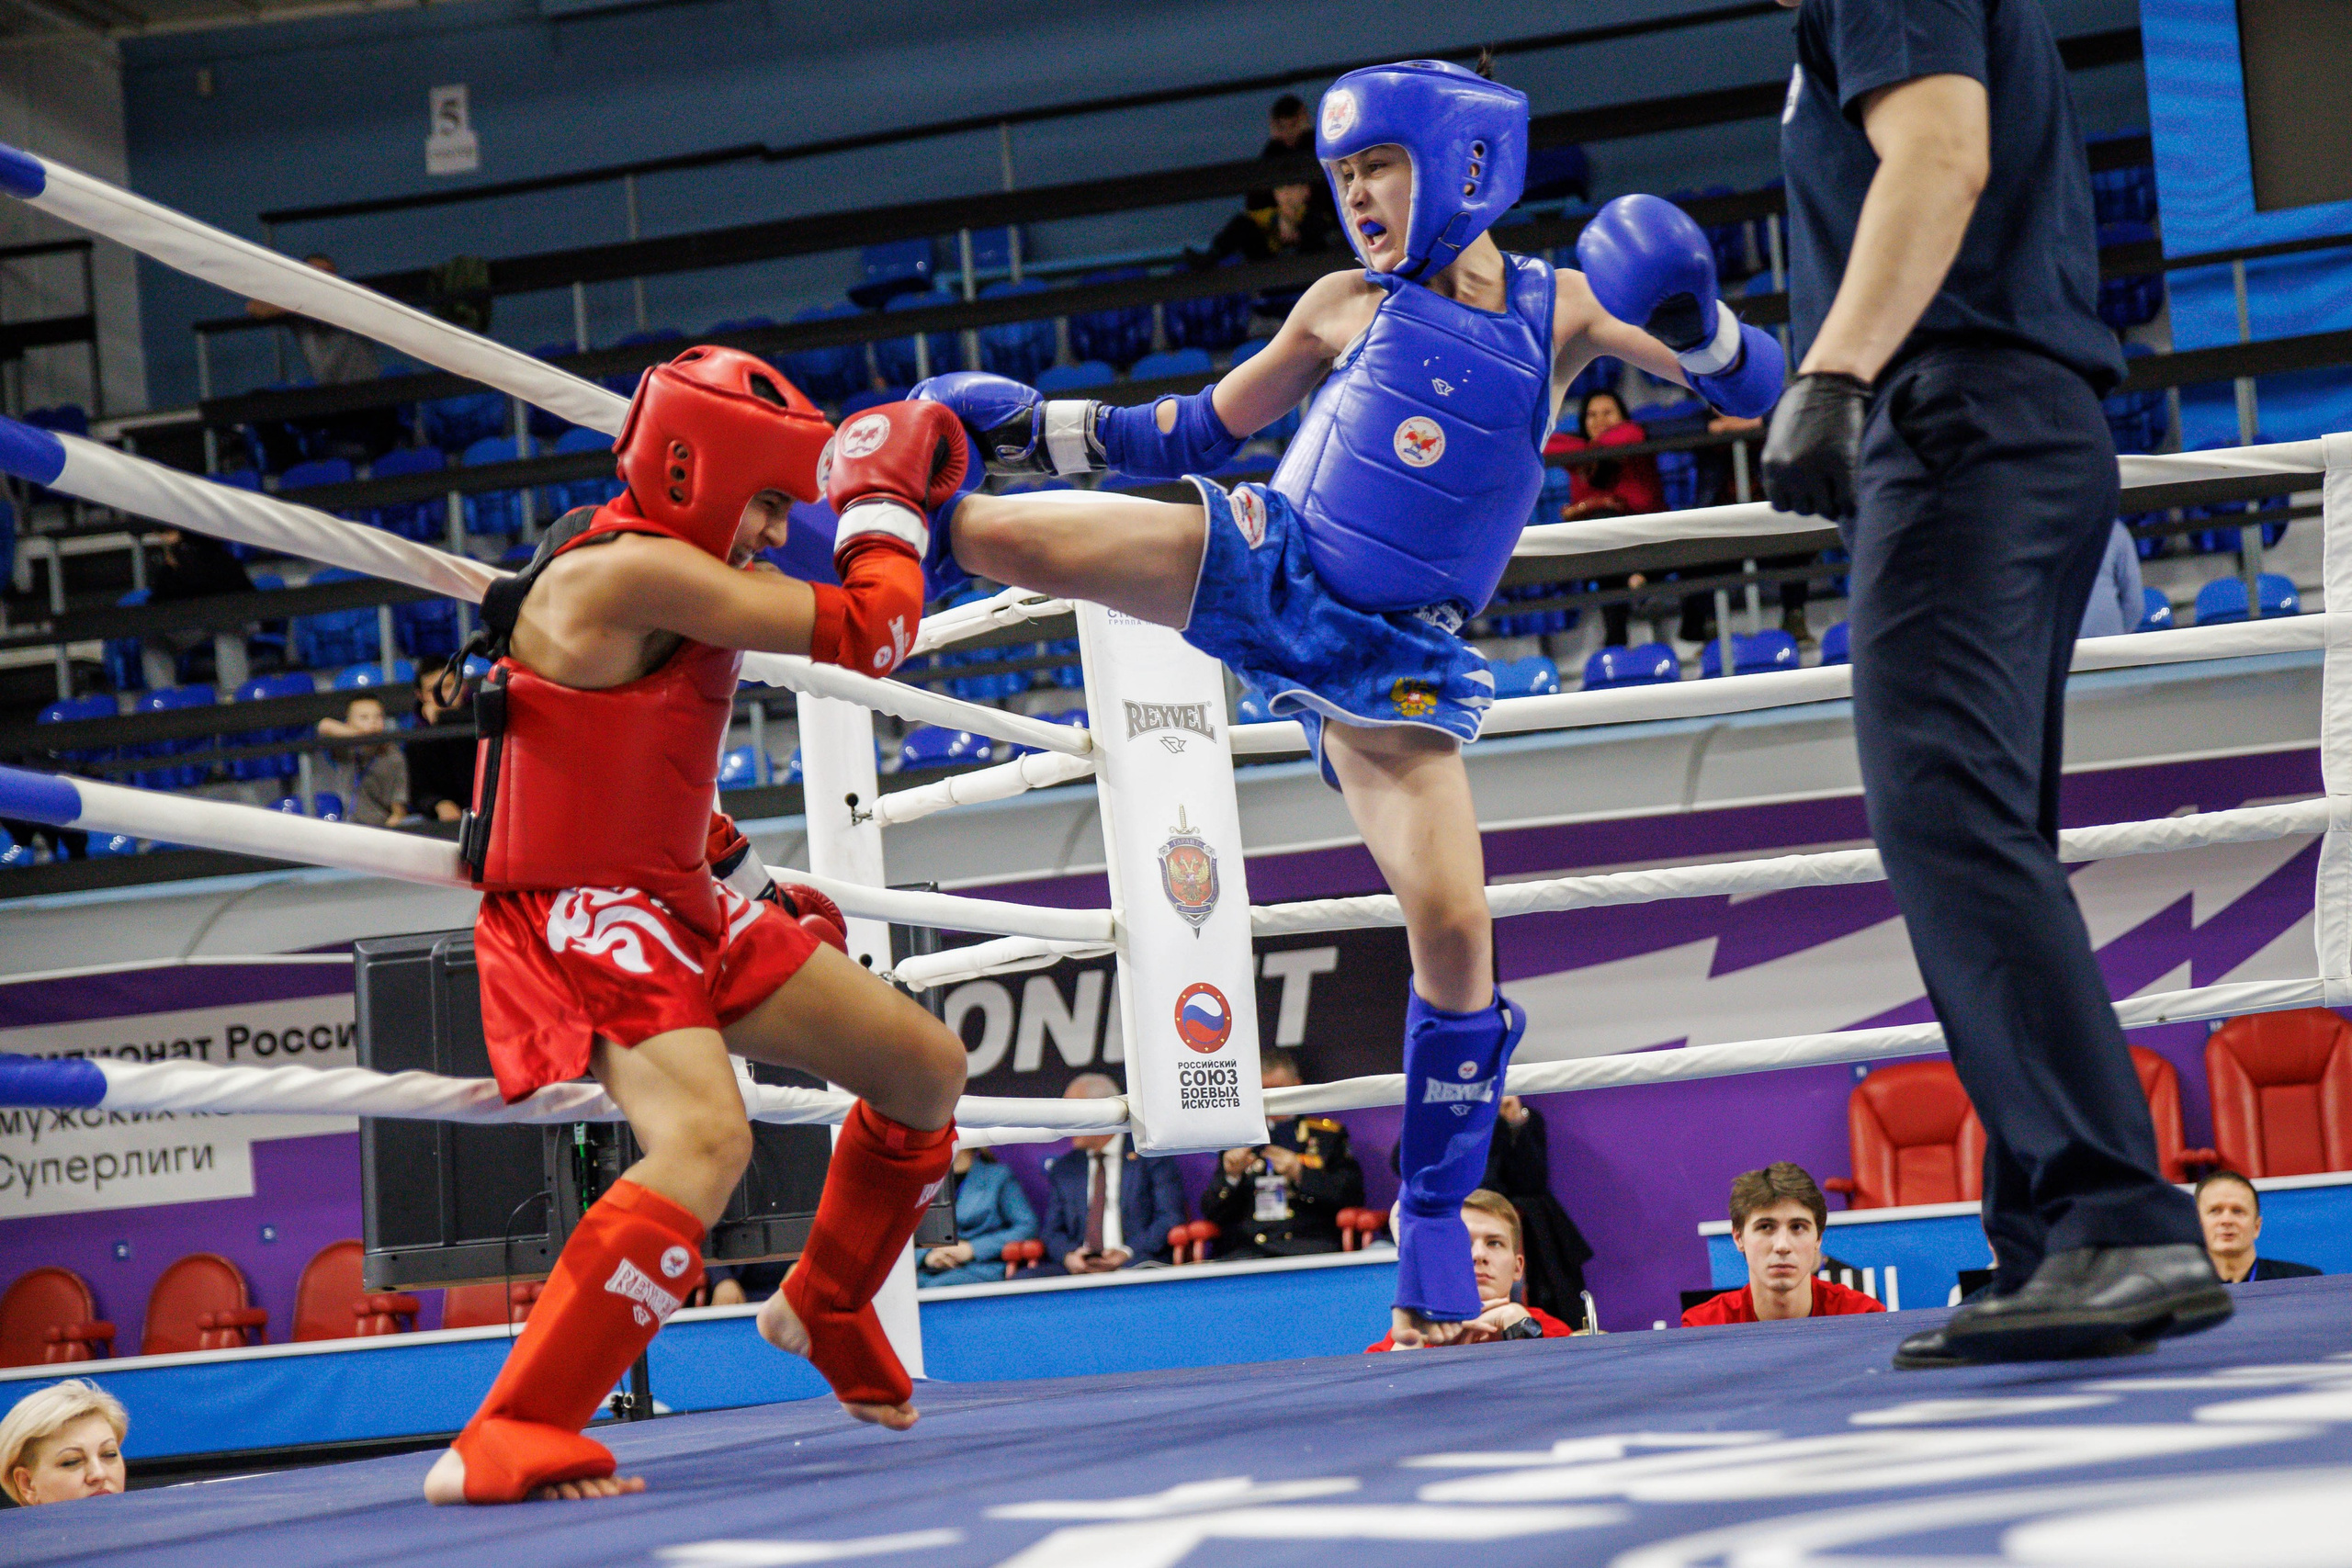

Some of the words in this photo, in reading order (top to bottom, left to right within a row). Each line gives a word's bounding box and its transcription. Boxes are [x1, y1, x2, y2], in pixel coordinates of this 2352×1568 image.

[439, 98, 460, 137] 5
[1121, 698, 1217, 744] REYVEL
[1178, 1059, 1237, 1069] РОССИЙСКИЙ
[1179, 1068, 1238, 1087] СОЮЗ
[1181, 1086, 1239, 1099] БОЕВЫХ
[1182, 1098, 1240, 1110] ИСКУССТВ
